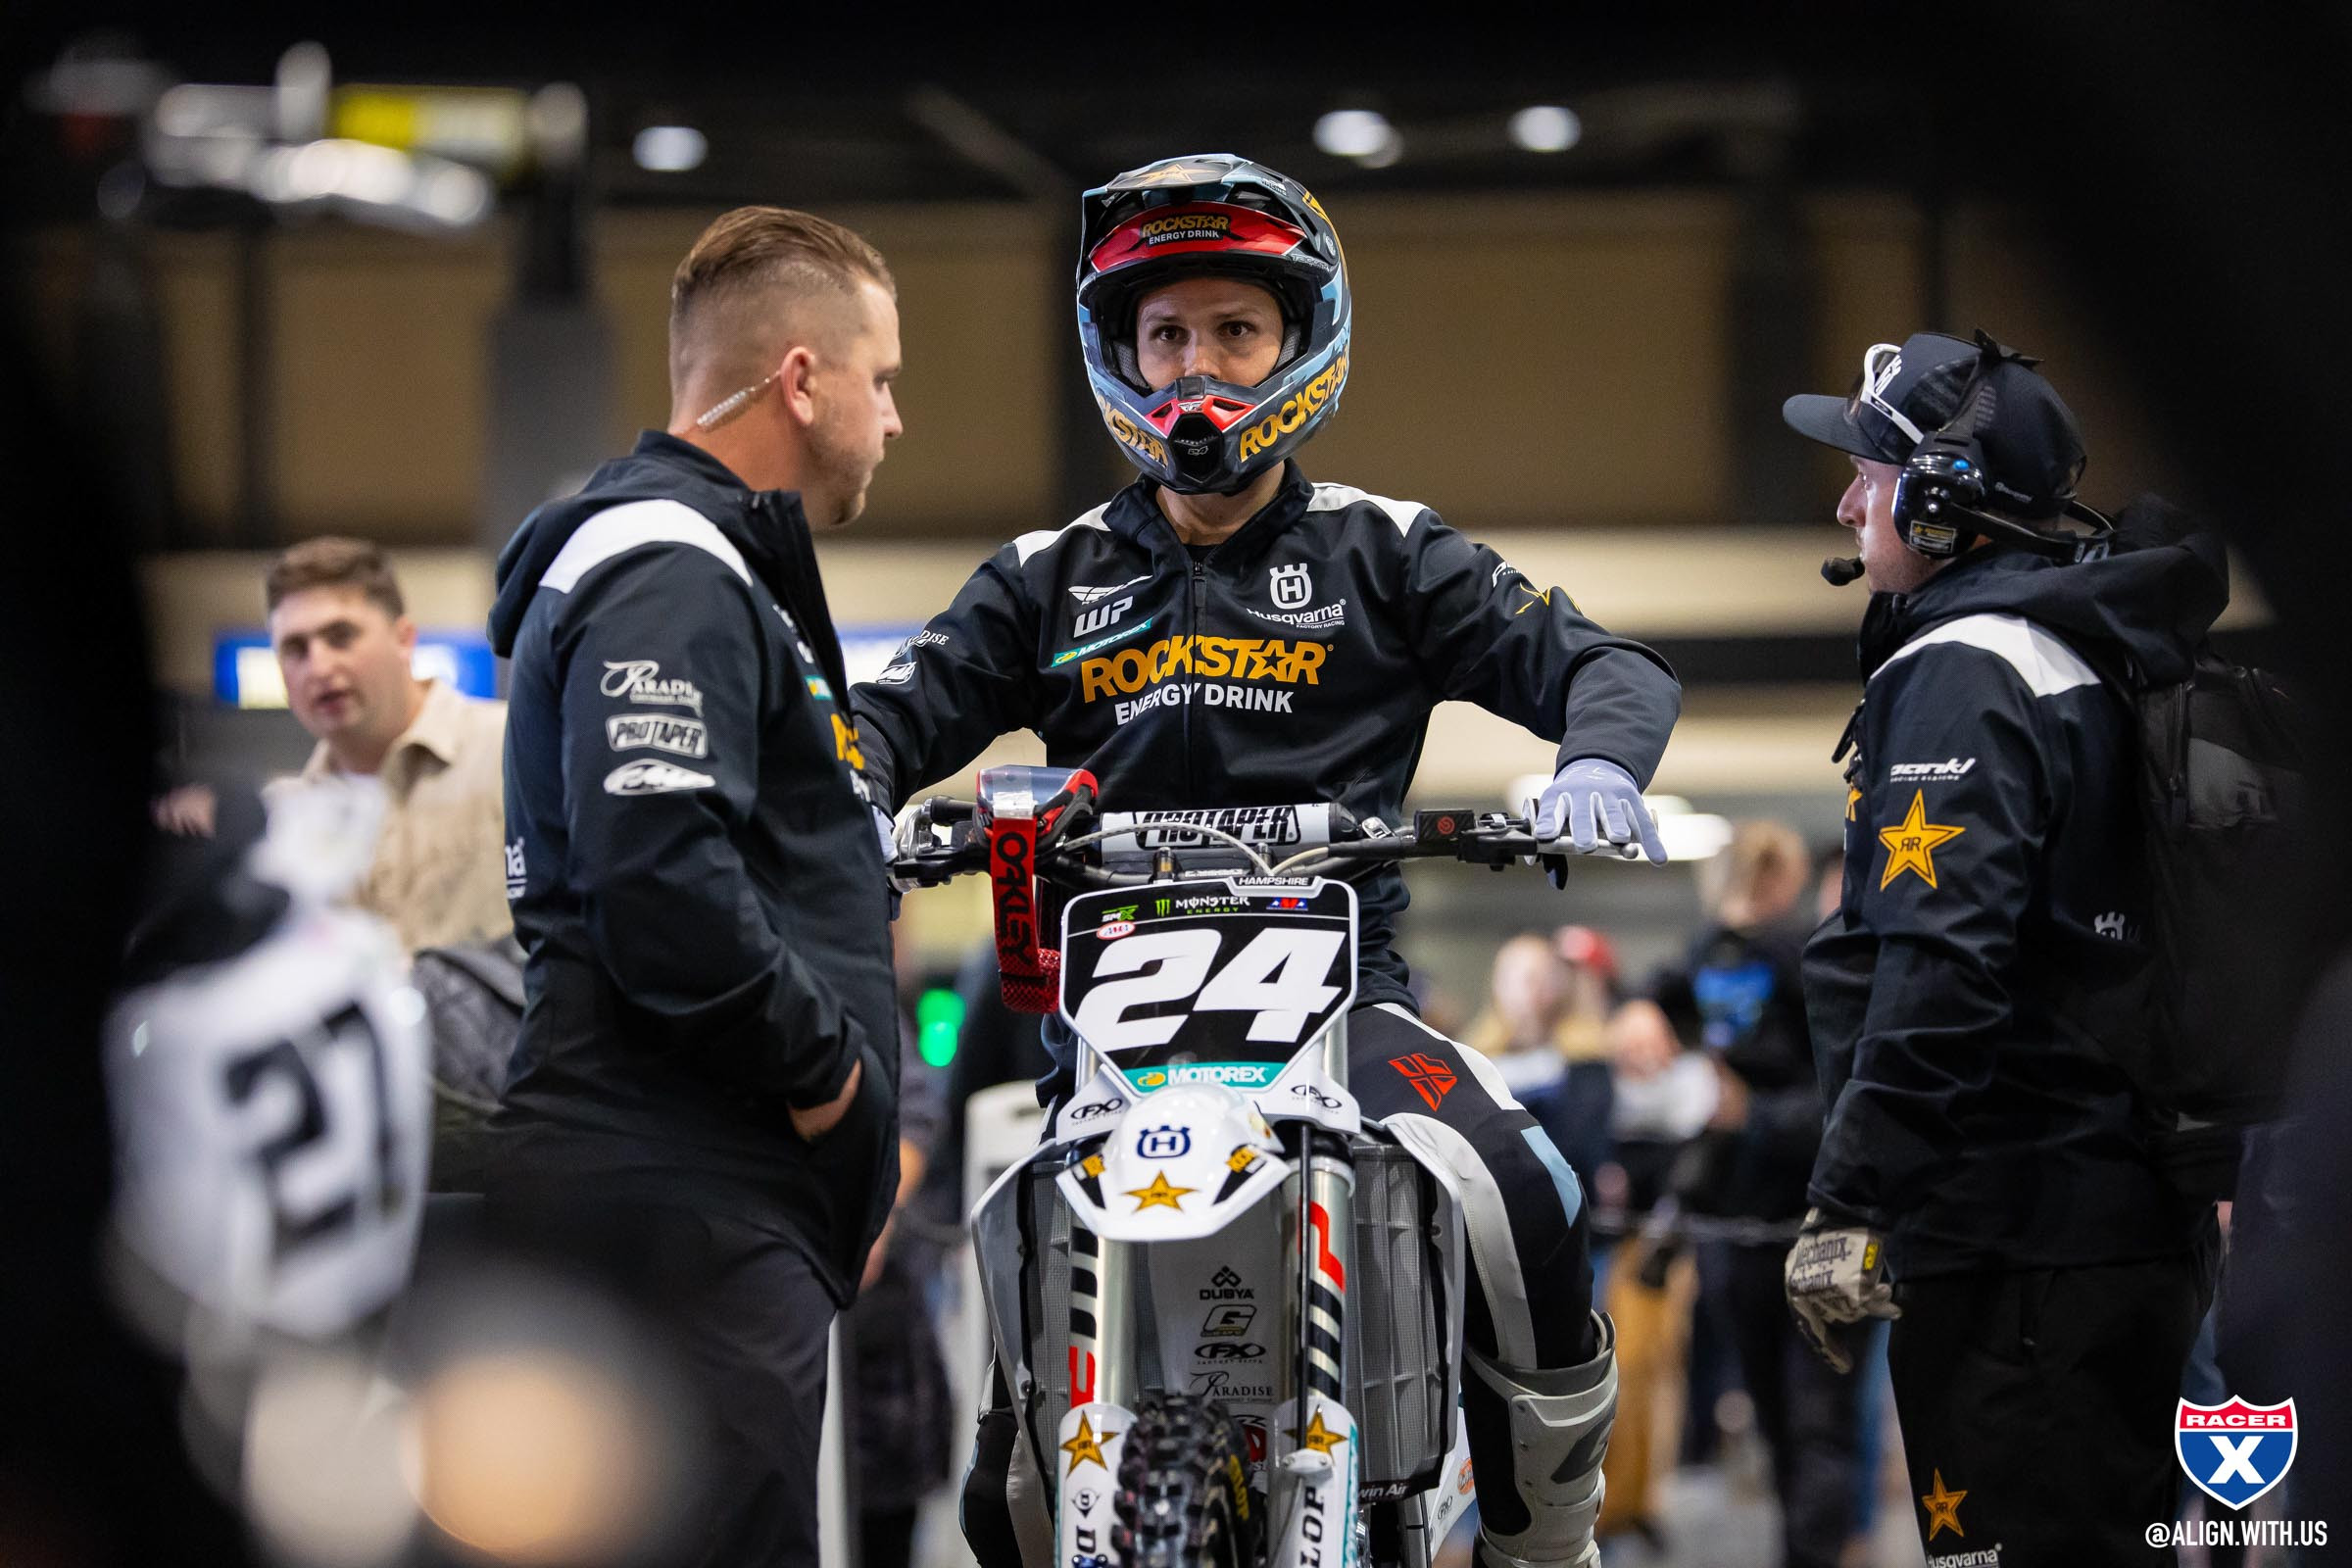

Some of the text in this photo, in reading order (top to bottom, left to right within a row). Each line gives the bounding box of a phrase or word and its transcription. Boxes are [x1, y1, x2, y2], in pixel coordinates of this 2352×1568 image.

[1142, 217, 1229, 237] ROCKSTAR
[1149, 229, 1219, 245] ENERGY DRINK
[1074, 596, 1134, 638] WP
[1246, 603, 1344, 625] Husqvarna
[1081, 635, 1326, 704] ROCKSTAR
[1114, 682, 1295, 726] ENERGY DRINK
[1239, 876, 1309, 886] HAMPSHIRE
[996, 831, 1031, 965] OAKLEY
[1176, 896, 1250, 909] MONSTER
[1187, 906, 1240, 915] ENERGY
[1075, 927, 1347, 1053] 24
[1168, 1065, 1267, 1084] MOTOREX
[1200, 1289, 1254, 1300] DUBYA
[1386, 1483, 1408, 1496] Air
